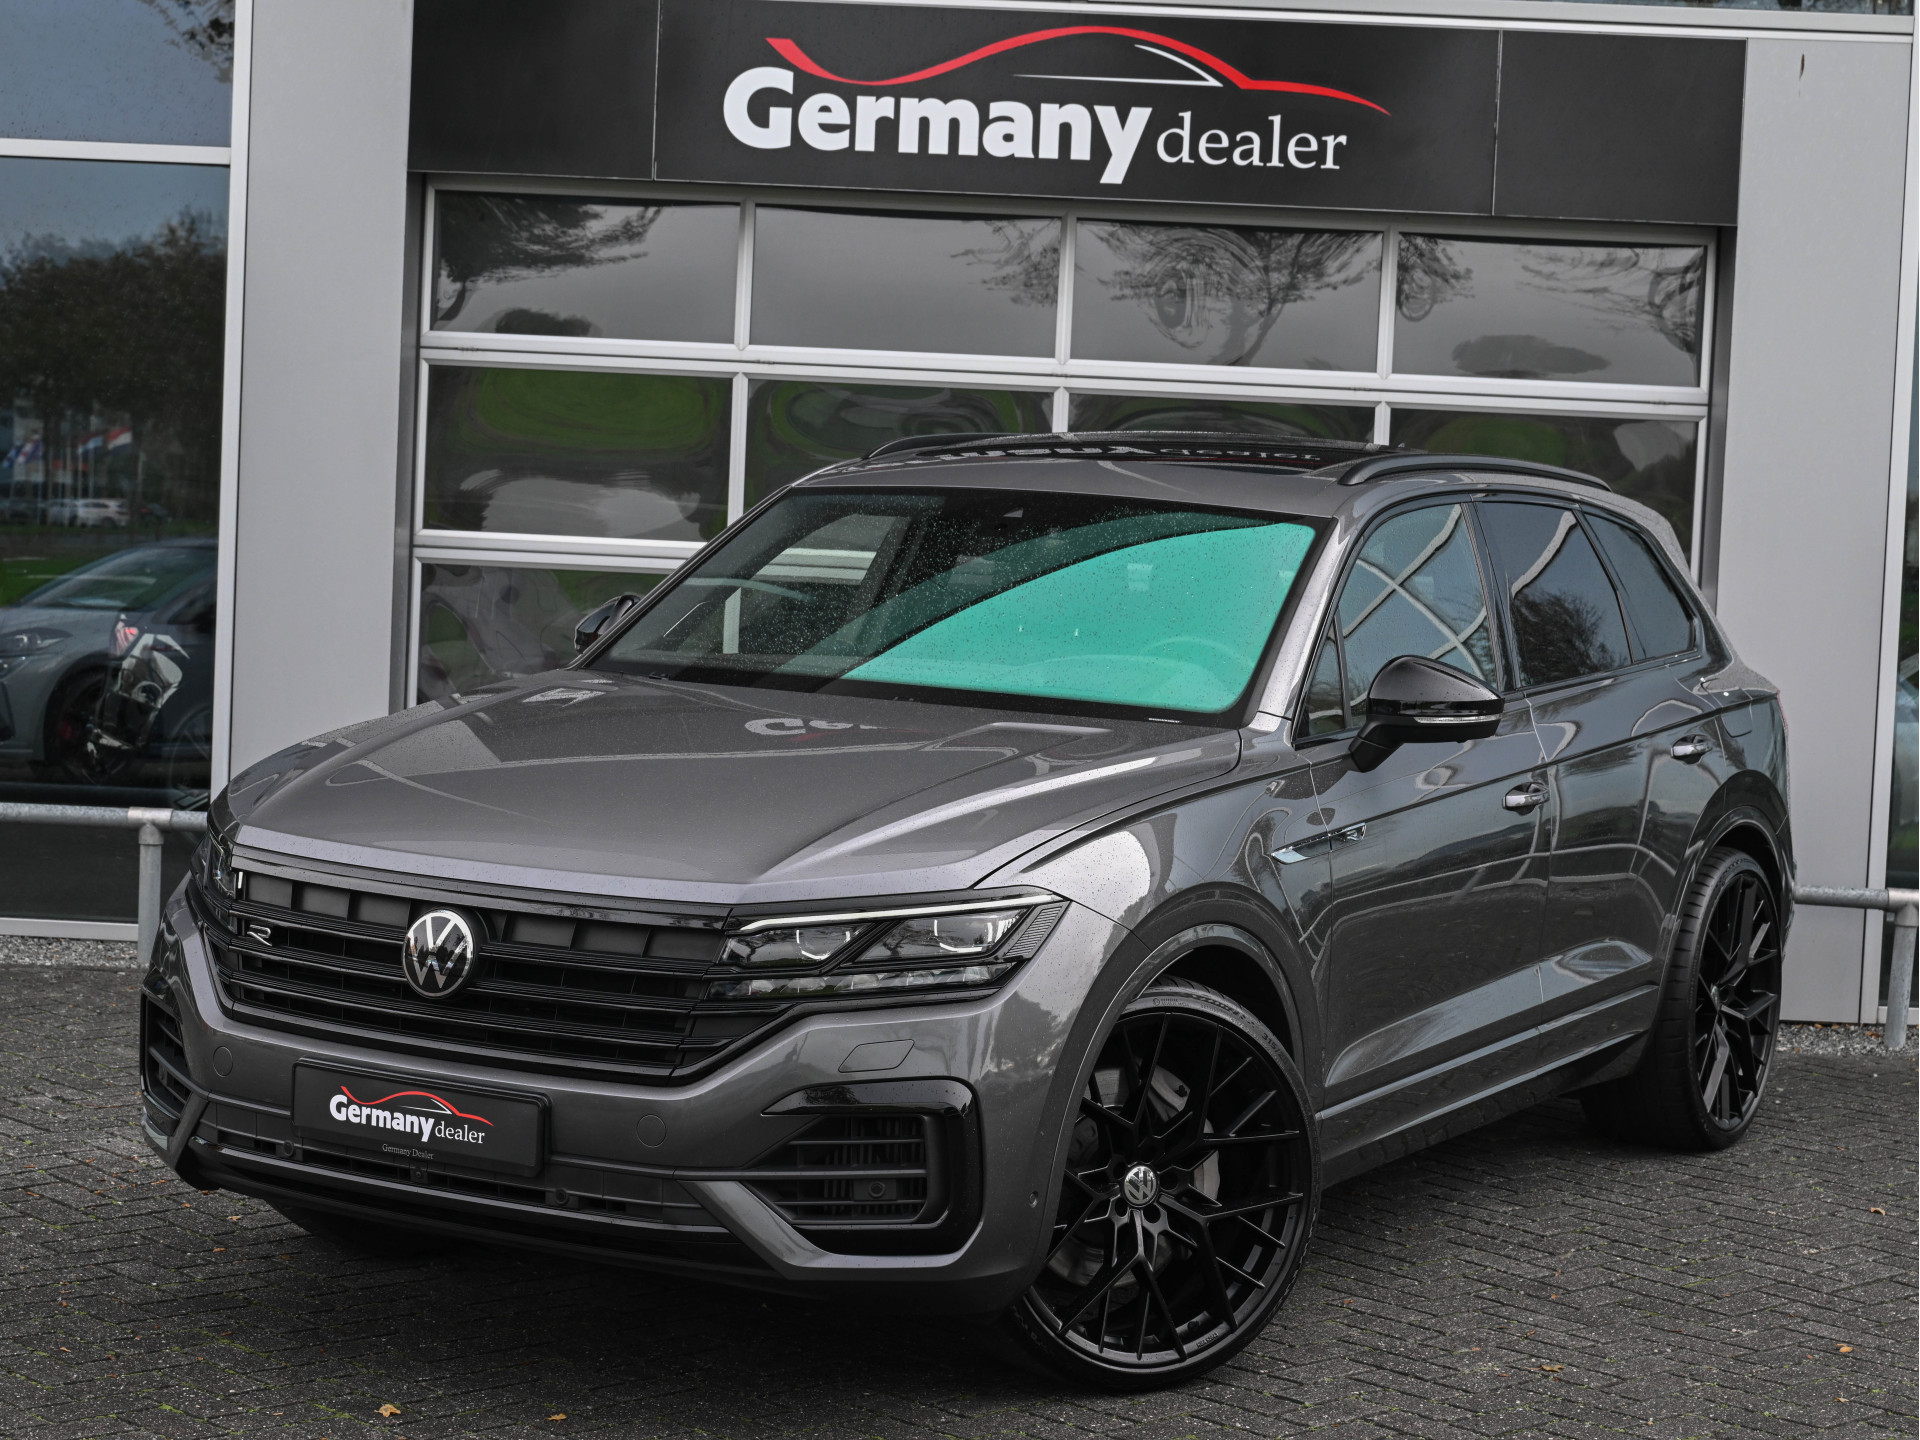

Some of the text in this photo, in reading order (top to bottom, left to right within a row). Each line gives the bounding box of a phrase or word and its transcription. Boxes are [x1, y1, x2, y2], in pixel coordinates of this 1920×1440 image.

[723, 66, 1348, 185] Germany dealer
[246, 924, 273, 947] R
[329, 1094, 486, 1144] Germany dealer
[382, 1143, 435, 1160] Germany Dealer
